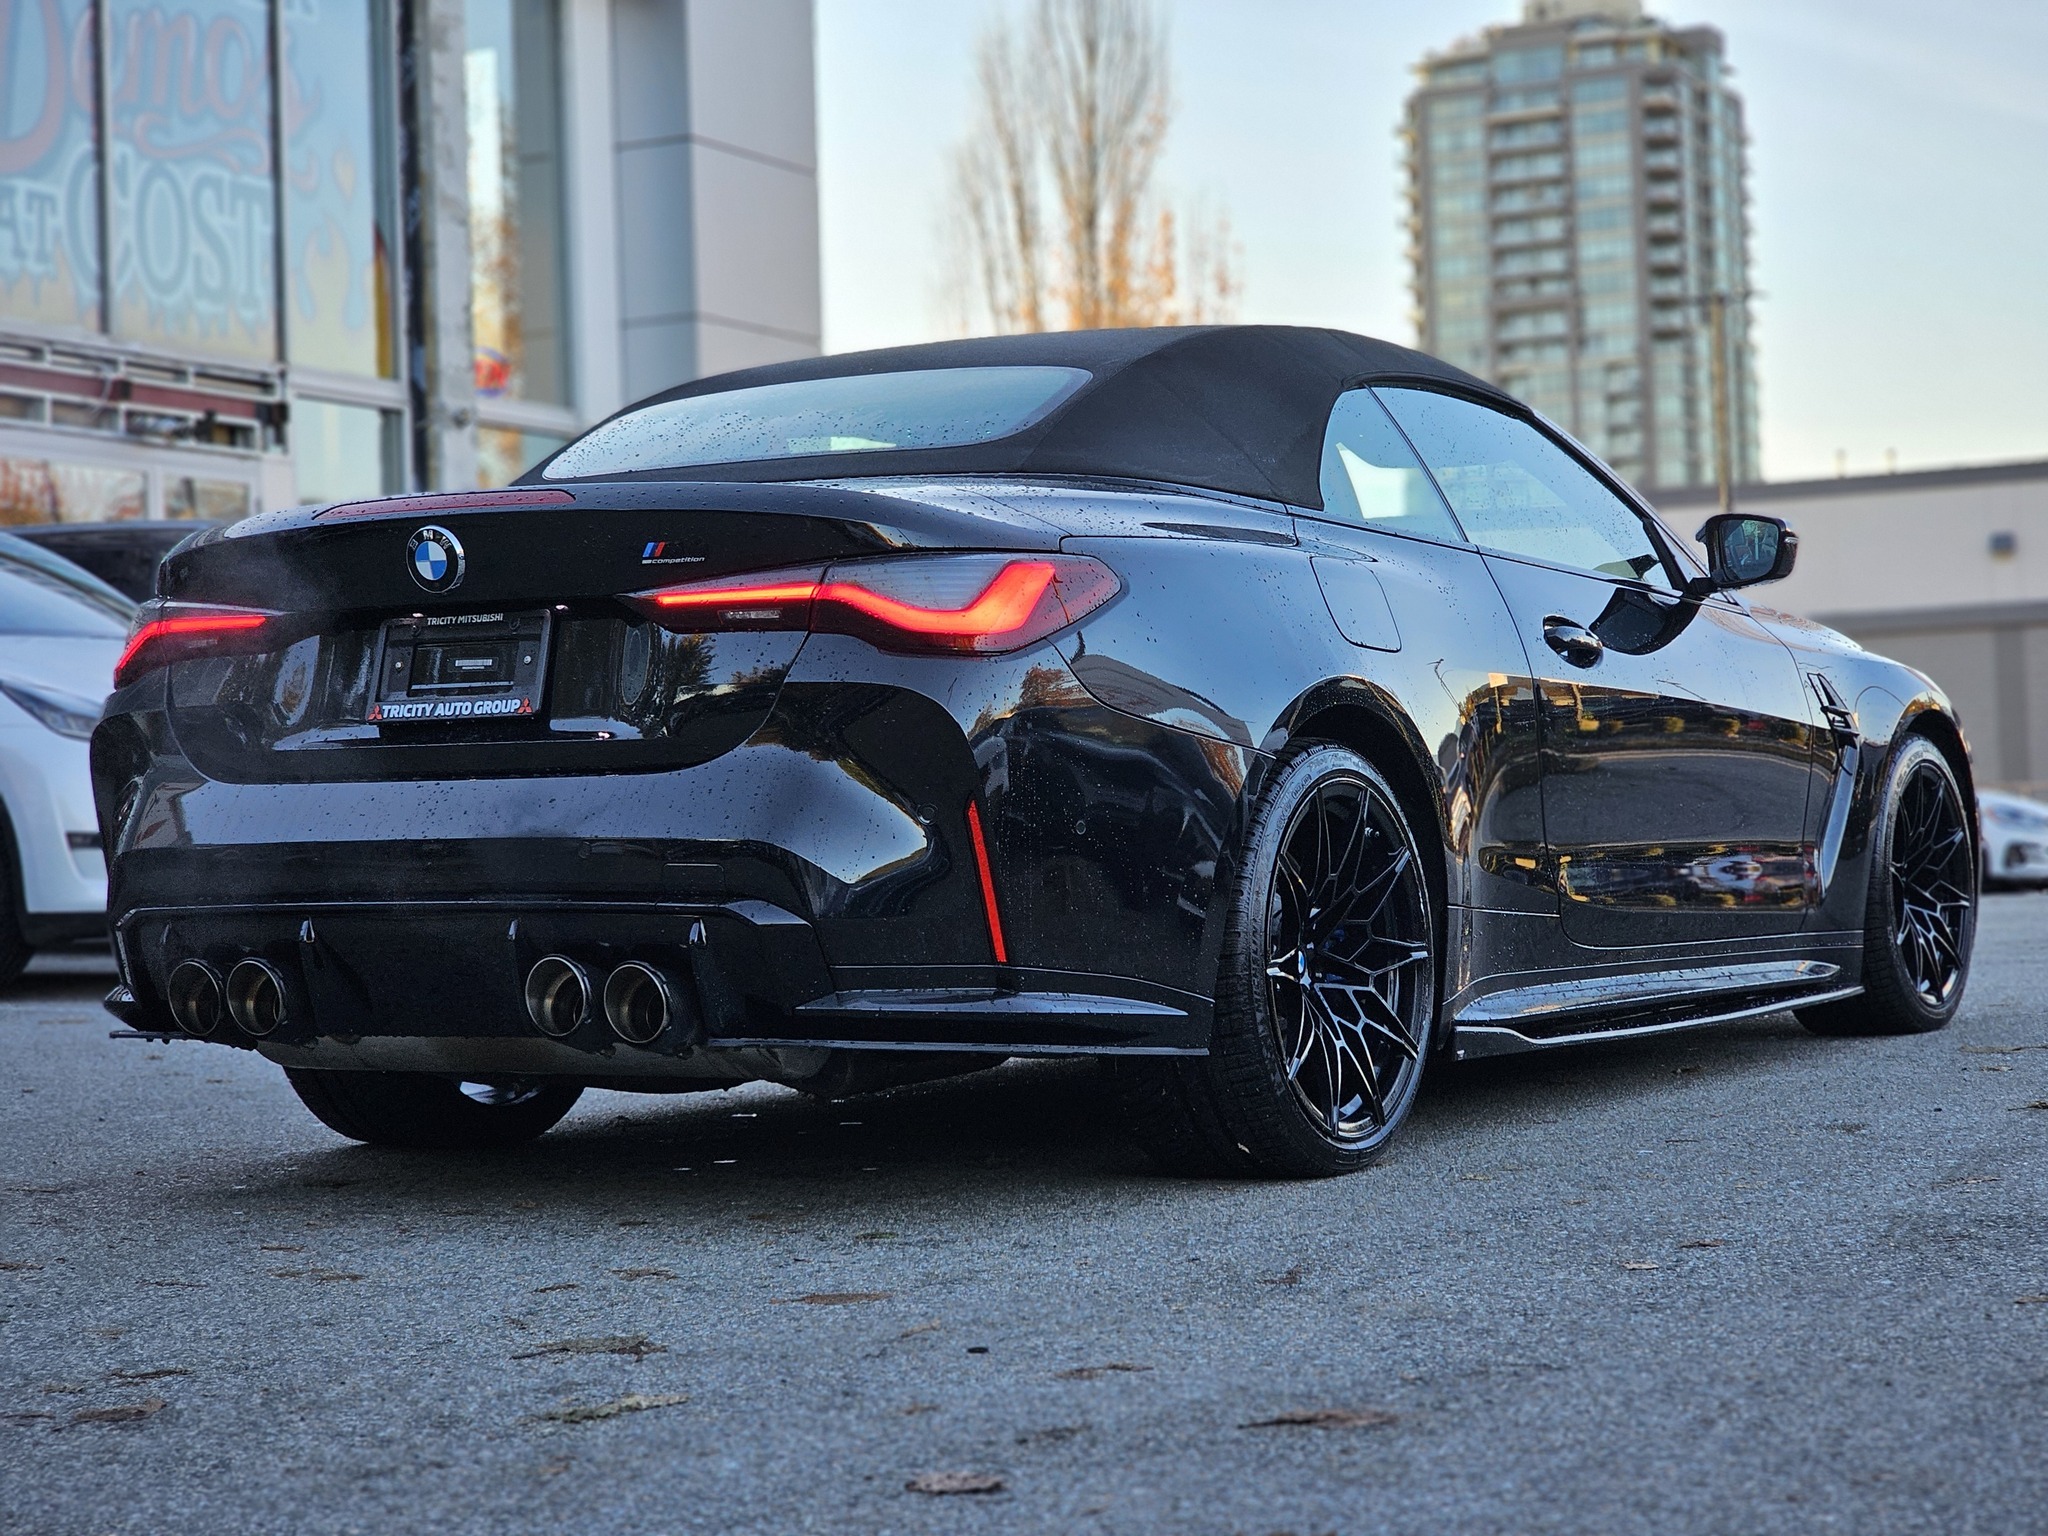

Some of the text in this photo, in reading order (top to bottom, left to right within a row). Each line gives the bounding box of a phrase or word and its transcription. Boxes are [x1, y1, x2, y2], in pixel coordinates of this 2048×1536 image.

[60, 143, 273, 306] COST
[410, 529, 452, 551] BMW
[652, 556, 705, 565] competition
[427, 612, 504, 626] TRICITY MITSUBISHI
[382, 699, 521, 718] TRICITY AUTO GROUP
